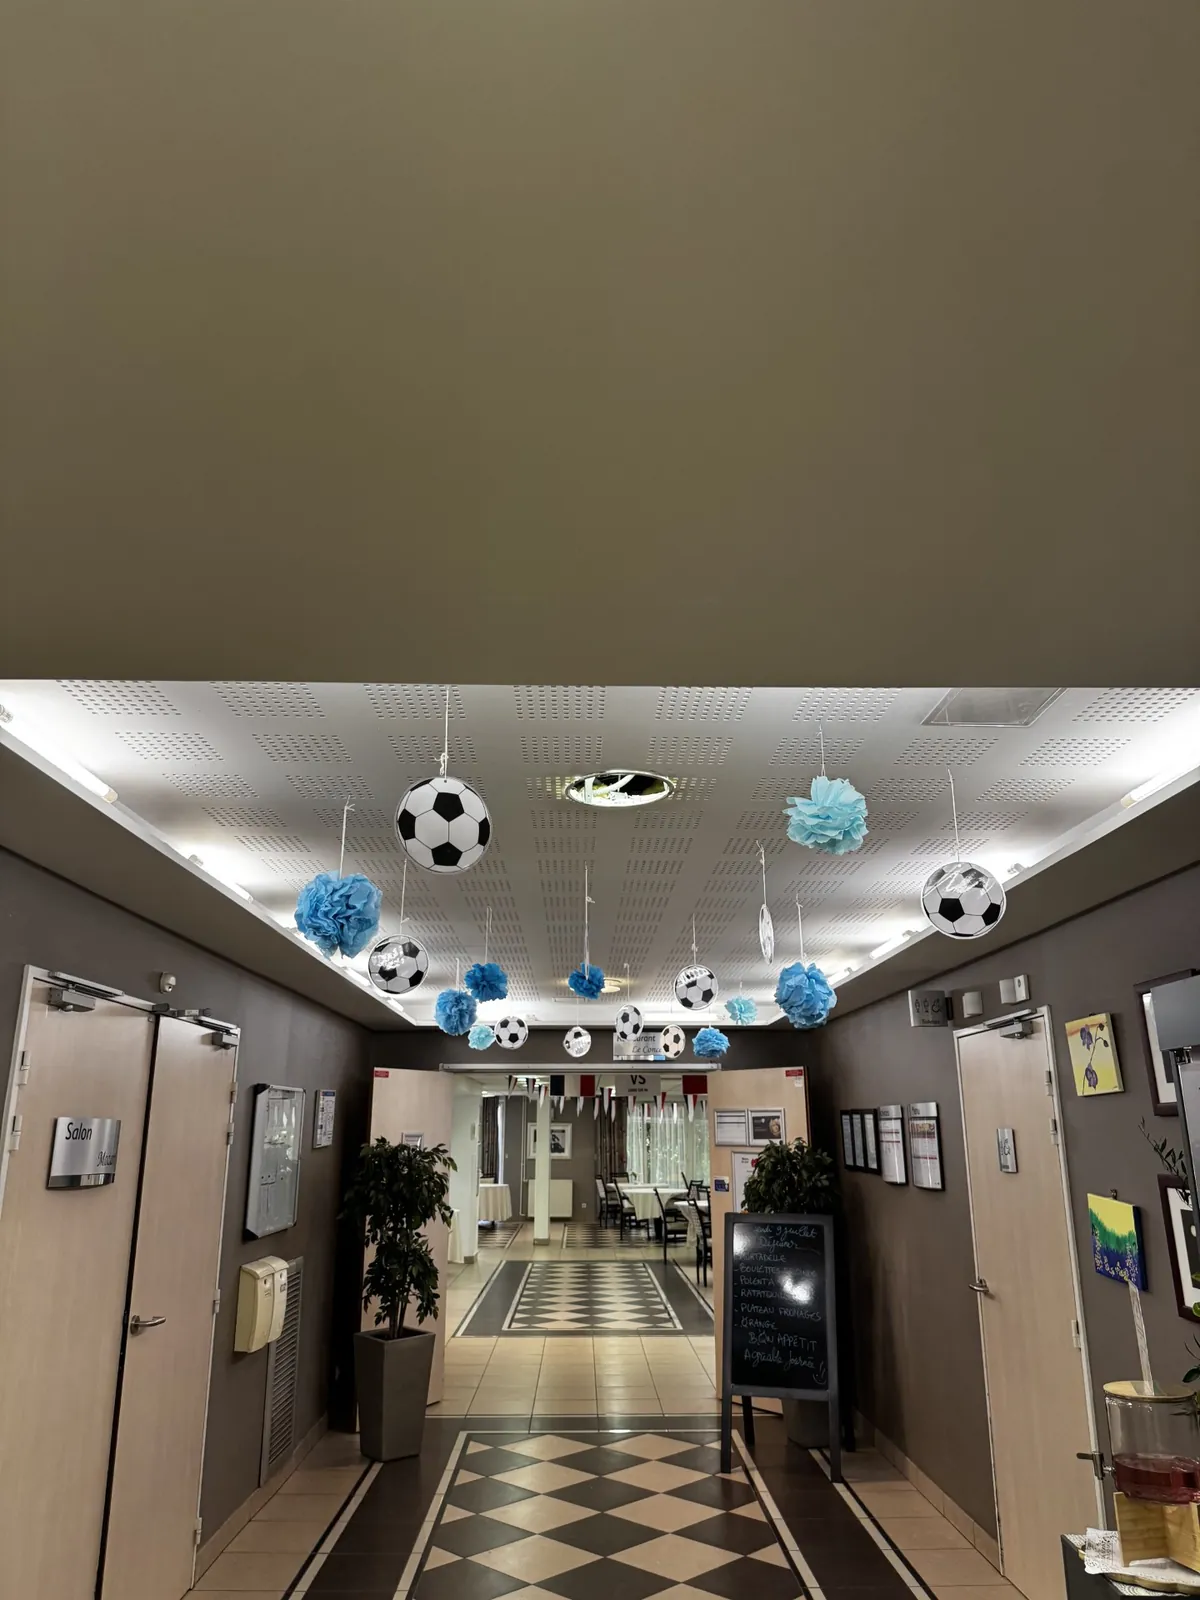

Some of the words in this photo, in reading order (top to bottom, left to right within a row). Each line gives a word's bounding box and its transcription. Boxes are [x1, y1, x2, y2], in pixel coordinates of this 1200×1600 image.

[630, 1074, 646, 1085] VS
[65, 1122, 93, 1140] Salon
[740, 1275, 775, 1286] POLENTA
